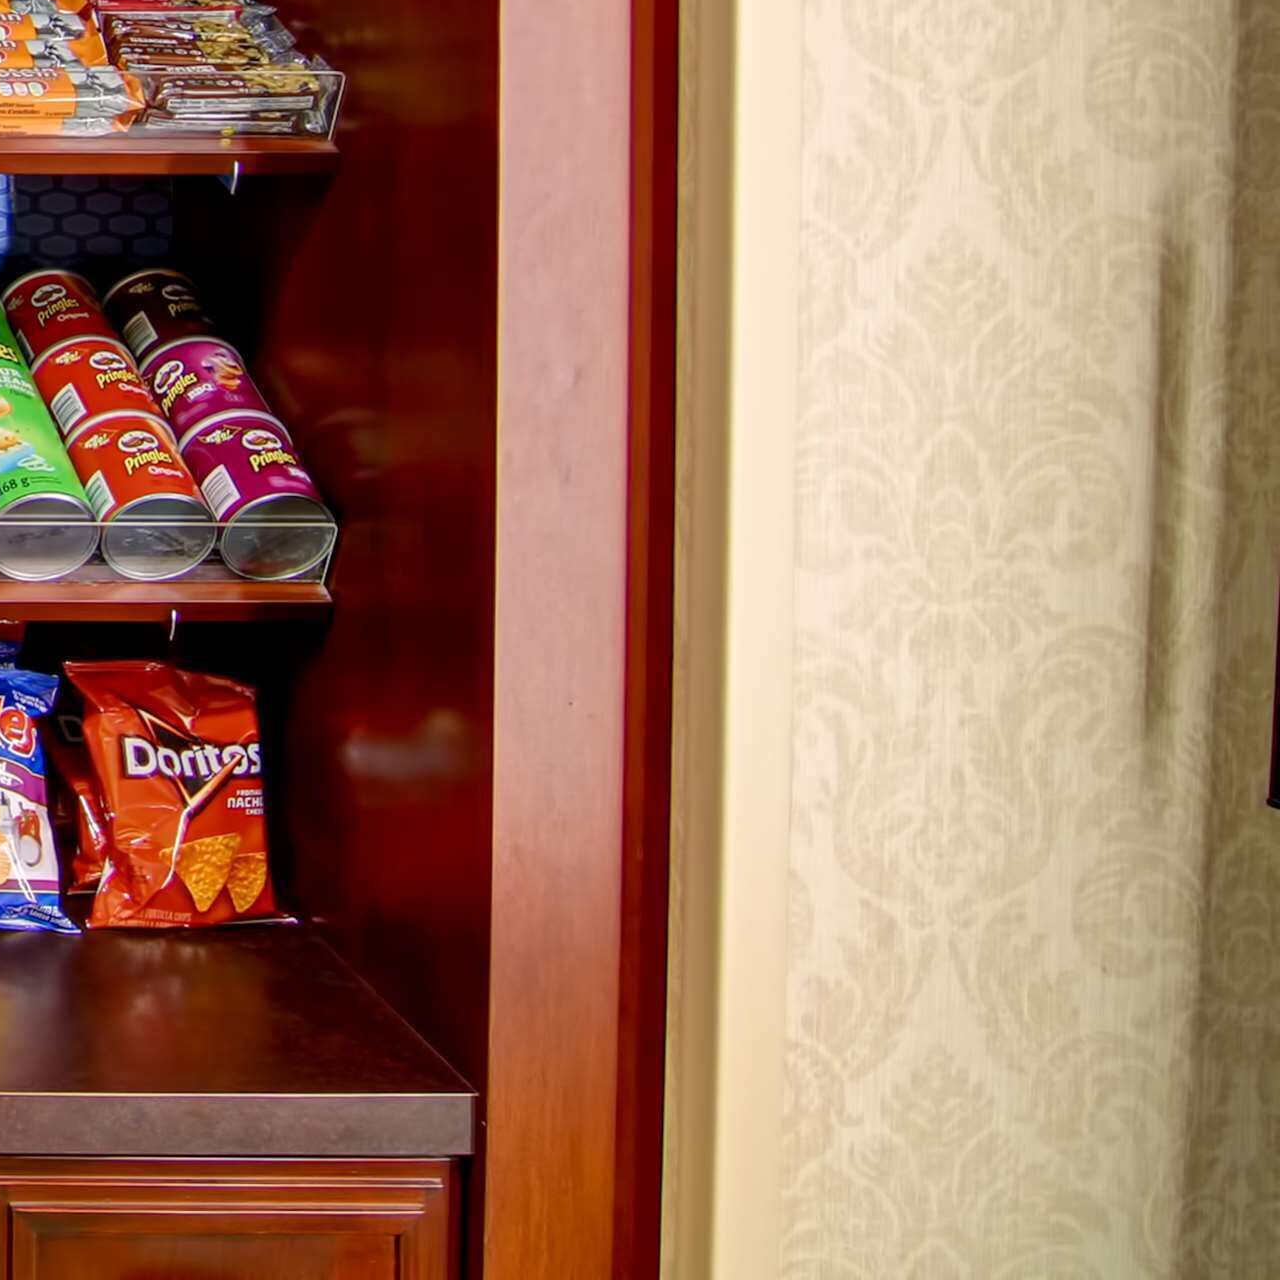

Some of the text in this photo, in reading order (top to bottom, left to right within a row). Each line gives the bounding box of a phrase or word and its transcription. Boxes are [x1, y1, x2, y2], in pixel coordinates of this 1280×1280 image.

[37, 297, 80, 327] Pringles
[95, 369, 139, 389] Pringles
[160, 373, 198, 418] Pringles
[124, 449, 173, 476] Pringles
[249, 449, 297, 473] Pringles
[123, 736, 262, 778] Doritos
